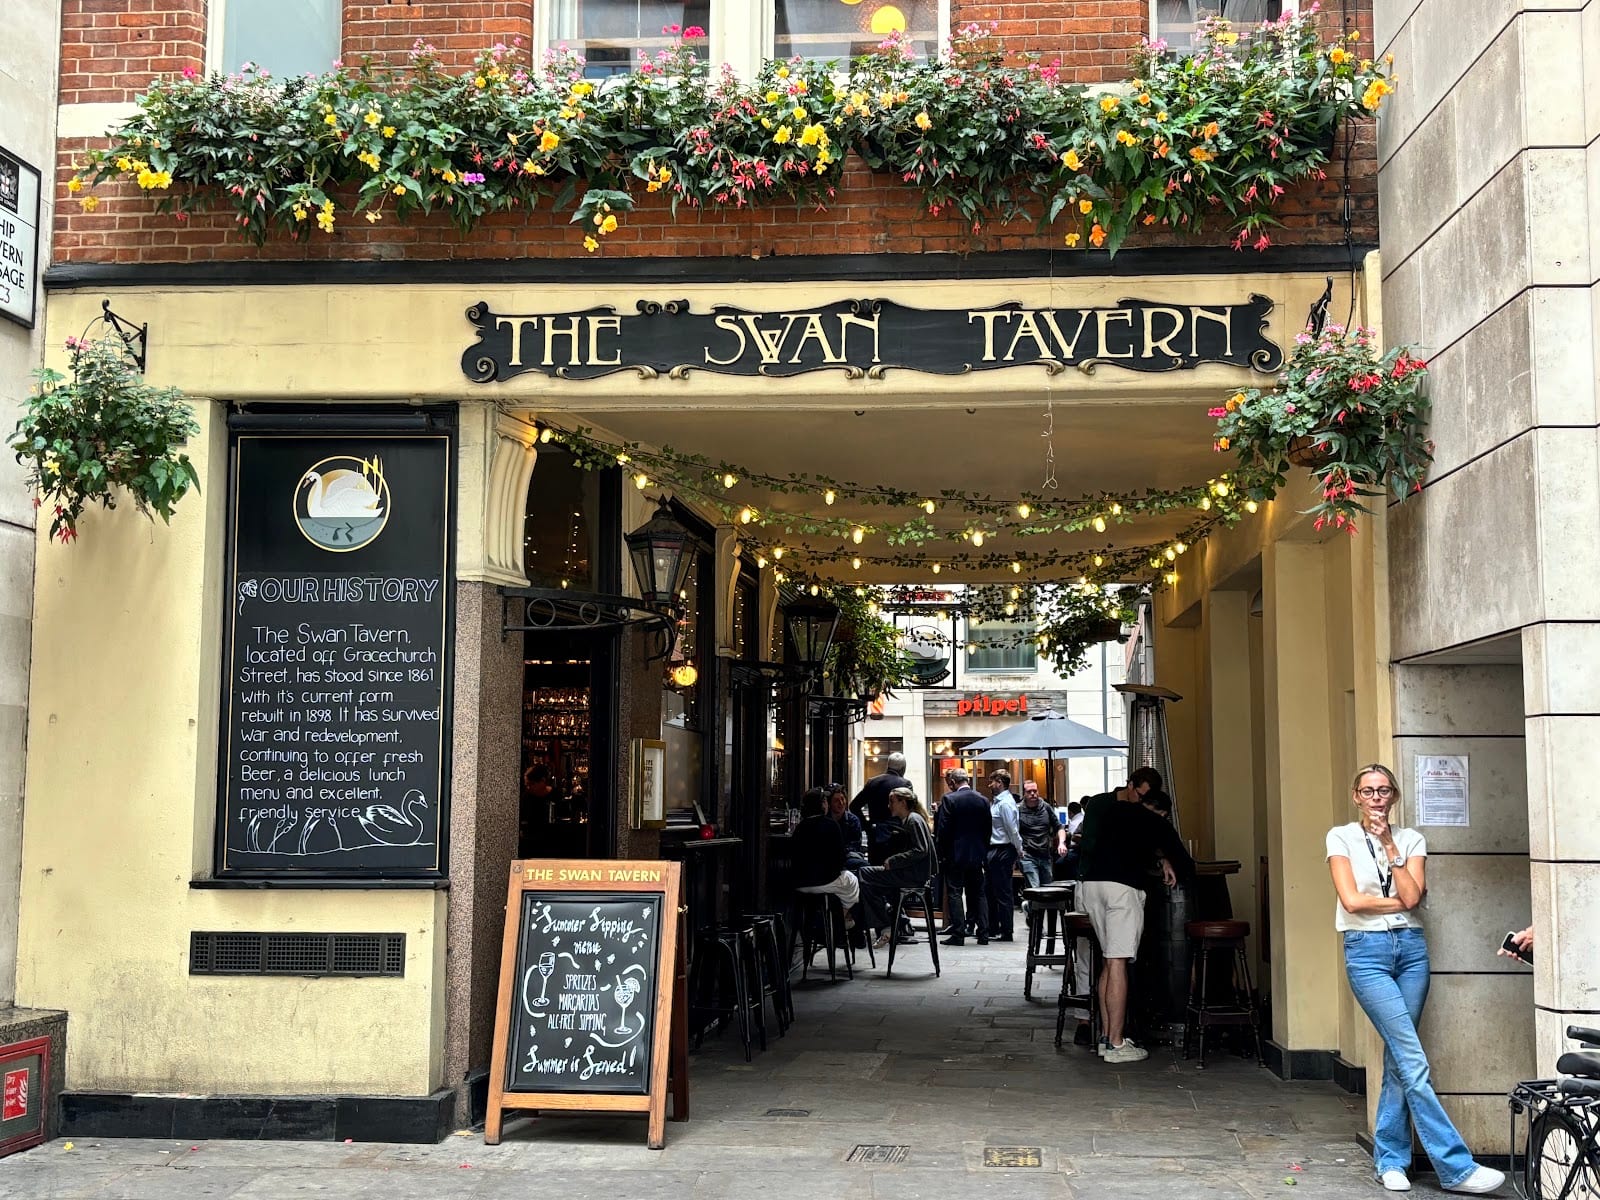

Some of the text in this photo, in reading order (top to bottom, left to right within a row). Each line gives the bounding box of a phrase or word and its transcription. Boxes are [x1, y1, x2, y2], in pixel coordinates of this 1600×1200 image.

[495, 307, 1233, 366] THE SWAN TAVERN
[260, 576, 439, 603] OUR HISTORY
[252, 625, 289, 644] The
[297, 622, 347, 645] Swan
[246, 644, 437, 666] located off Gracechurch
[296, 666, 321, 683] has
[324, 667, 364, 683] stood
[368, 668, 404, 682] since
[408, 667, 434, 682] 1861
[301, 689, 354, 704] current
[358, 691, 393, 706] form
[241, 708, 284, 723] rebuilt
[289, 709, 301, 722] in
[339, 706, 349, 722] It
[354, 705, 379, 722] has
[382, 705, 440, 722] survived
[273, 725, 300, 742] and
[240, 748, 424, 768] continuing to offer fresh
[284, 768, 293, 781] a
[300, 766, 360, 782] delicious
[369, 766, 406, 782] lunch
[240, 787, 280, 801] menu
[286, 786, 314, 800] and
[238, 804, 361, 824] friendly service
[527, 869, 660, 882] THE SWAN TAVERN
[536, 905, 644, 943] Summer Sipping
[522, 1045, 568, 1074] Summer
